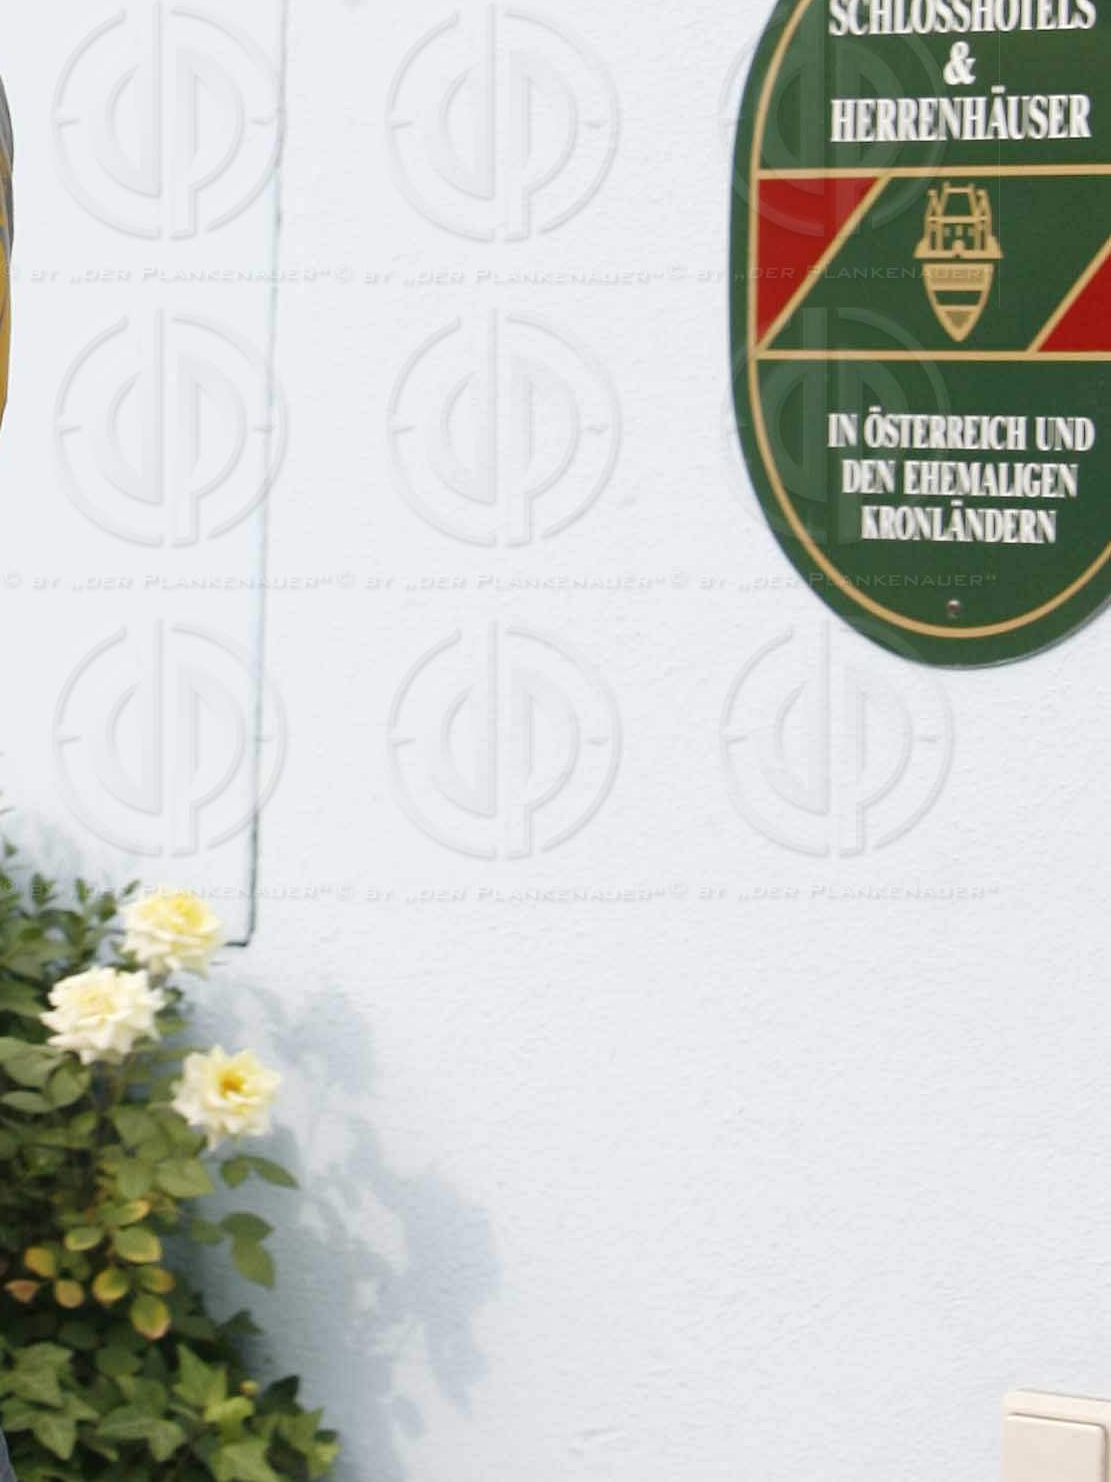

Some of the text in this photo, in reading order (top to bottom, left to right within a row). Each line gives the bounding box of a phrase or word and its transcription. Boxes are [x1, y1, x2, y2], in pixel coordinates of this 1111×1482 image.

[943, 40, 976, 86] &
[829, 86, 1092, 144] HERRENHÄUSER
[828, 405, 1096, 453] IN ÖSTERREICH UND
[841, 460, 1079, 499] DEN EHEMALIGEN
[860, 499, 1057, 545] KRONLÄNDERN
